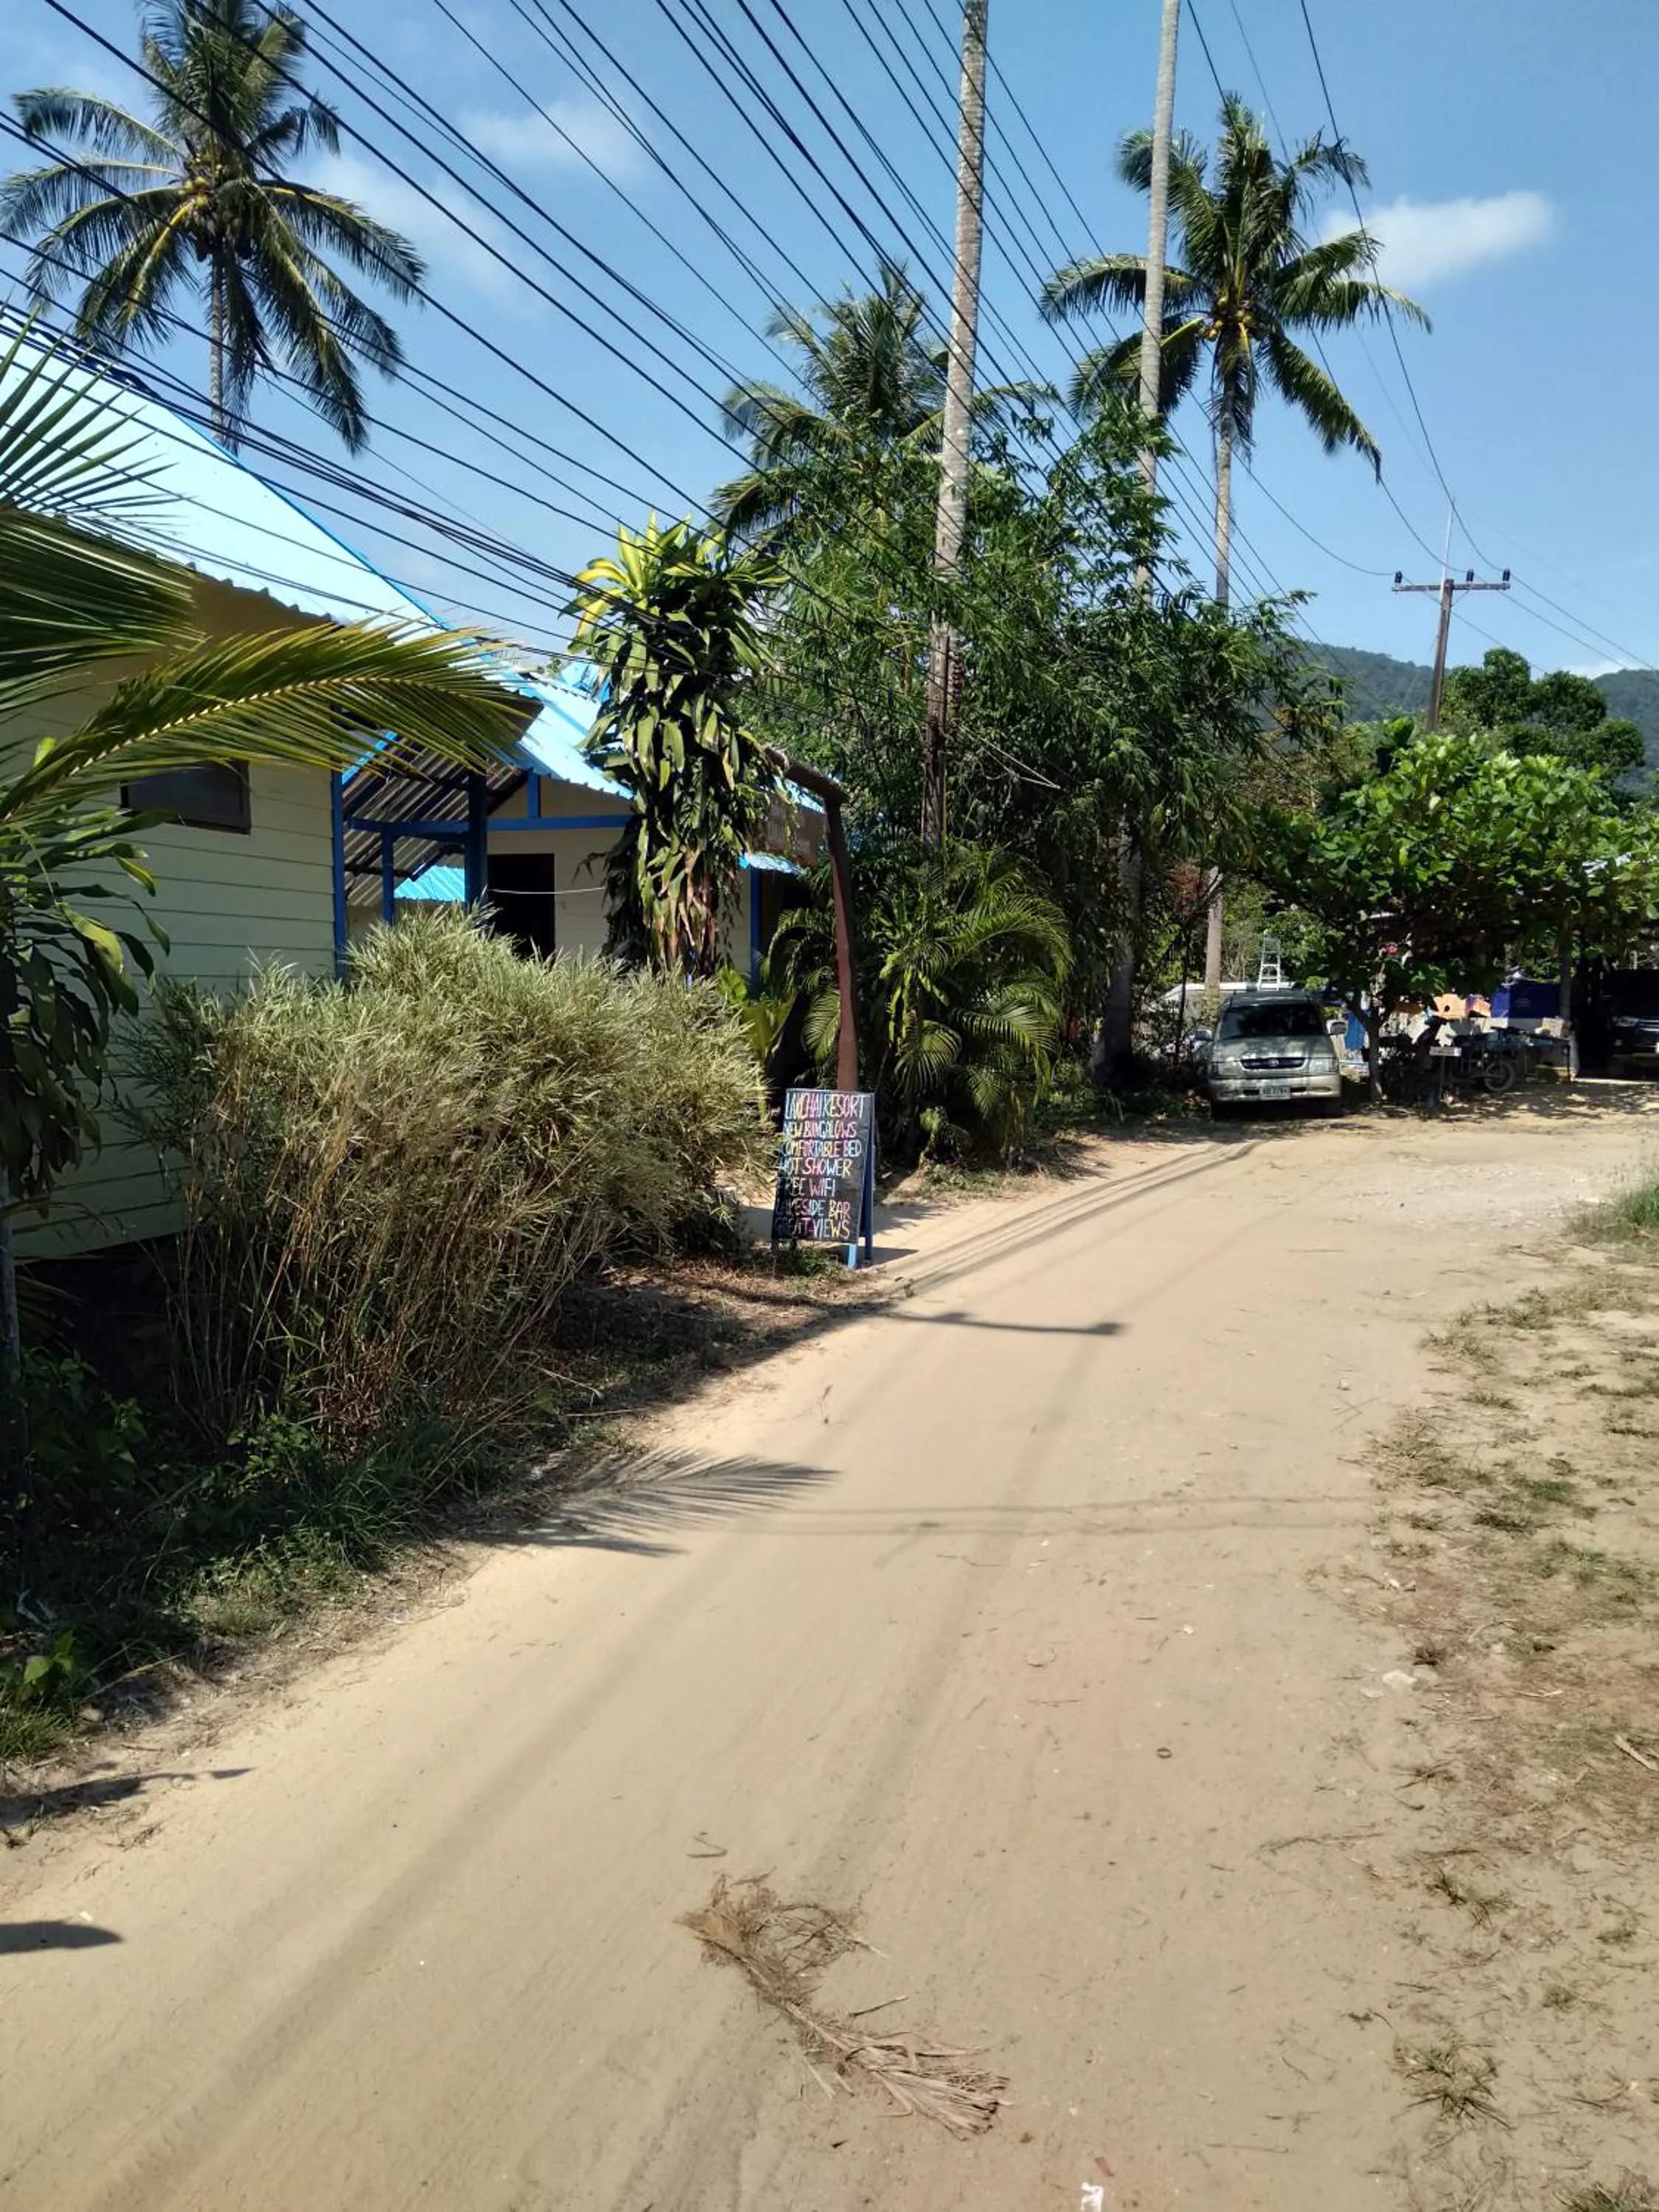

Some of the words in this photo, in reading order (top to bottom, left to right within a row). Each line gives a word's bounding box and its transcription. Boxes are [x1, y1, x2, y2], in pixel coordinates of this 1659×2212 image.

[823, 1093, 867, 1119] RESORT
[784, 1121, 802, 1138] NEW
[844, 1140, 862, 1158] BED
[779, 1157, 802, 1175] HOT
[802, 1157, 853, 1178] SHOWER
[809, 1178, 835, 1197] WIFI
[829, 1198, 851, 1220] BAR
